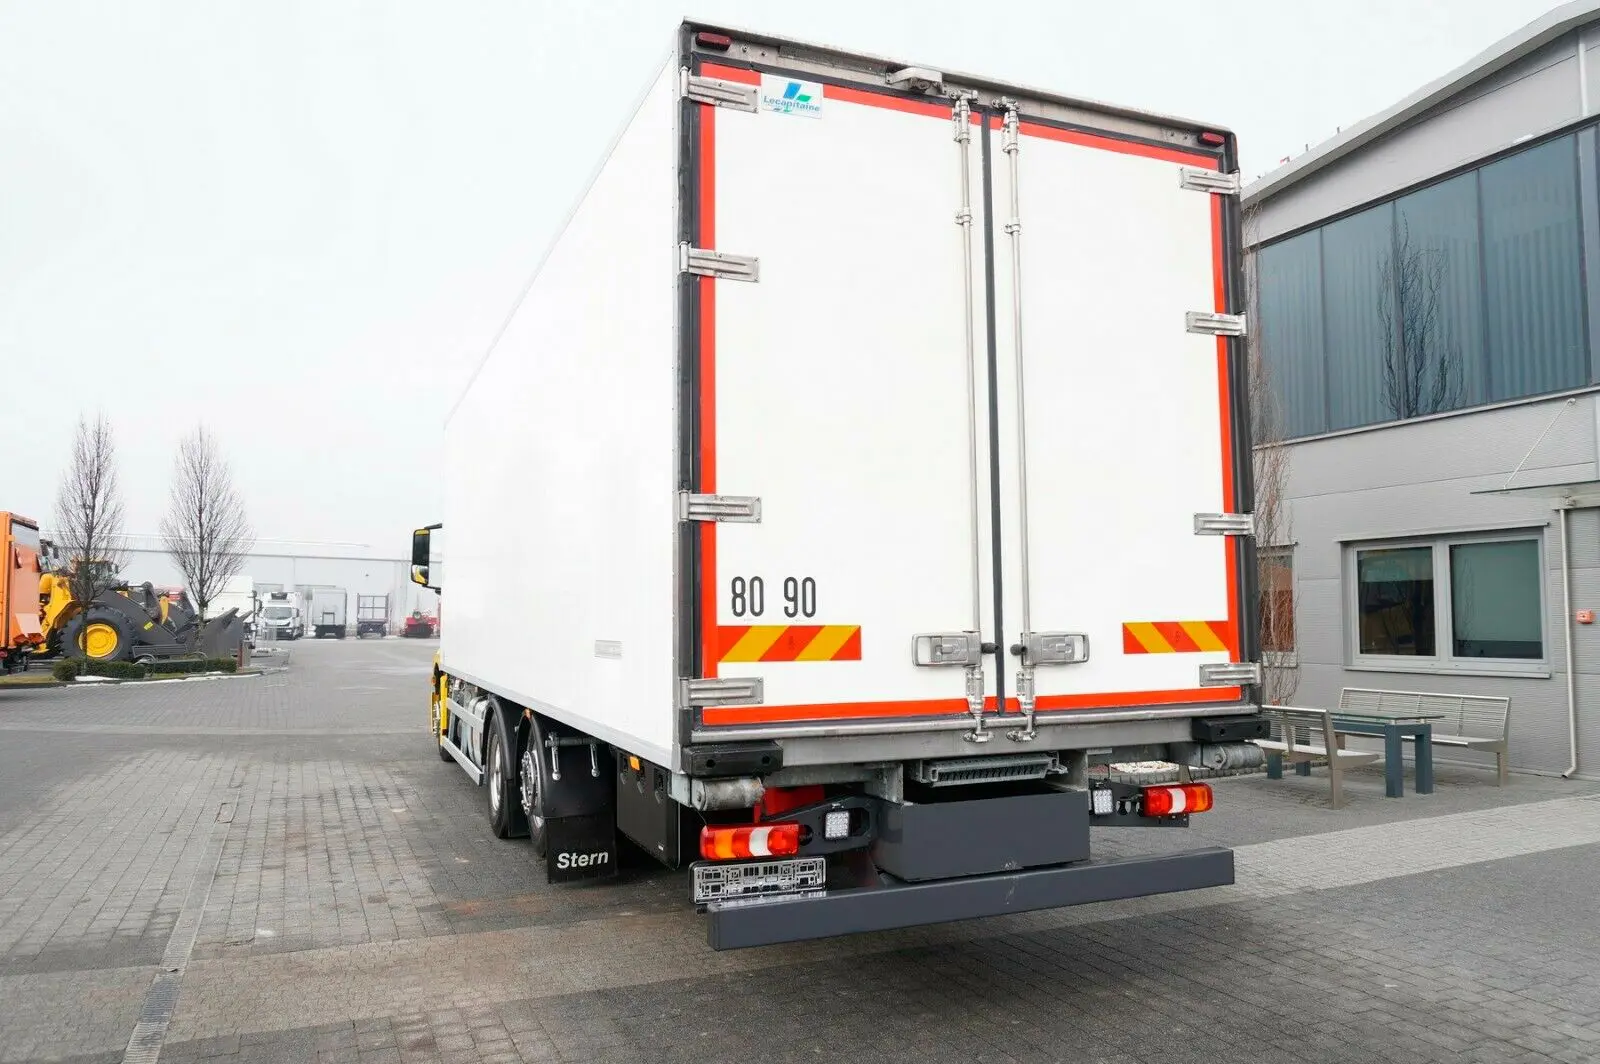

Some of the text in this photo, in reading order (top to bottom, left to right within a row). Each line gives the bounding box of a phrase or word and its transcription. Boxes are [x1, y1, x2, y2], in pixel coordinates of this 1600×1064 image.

[763, 95, 821, 112] Lecapitaine
[731, 576, 816, 618] 80 90
[556, 850, 609, 870] Stern
